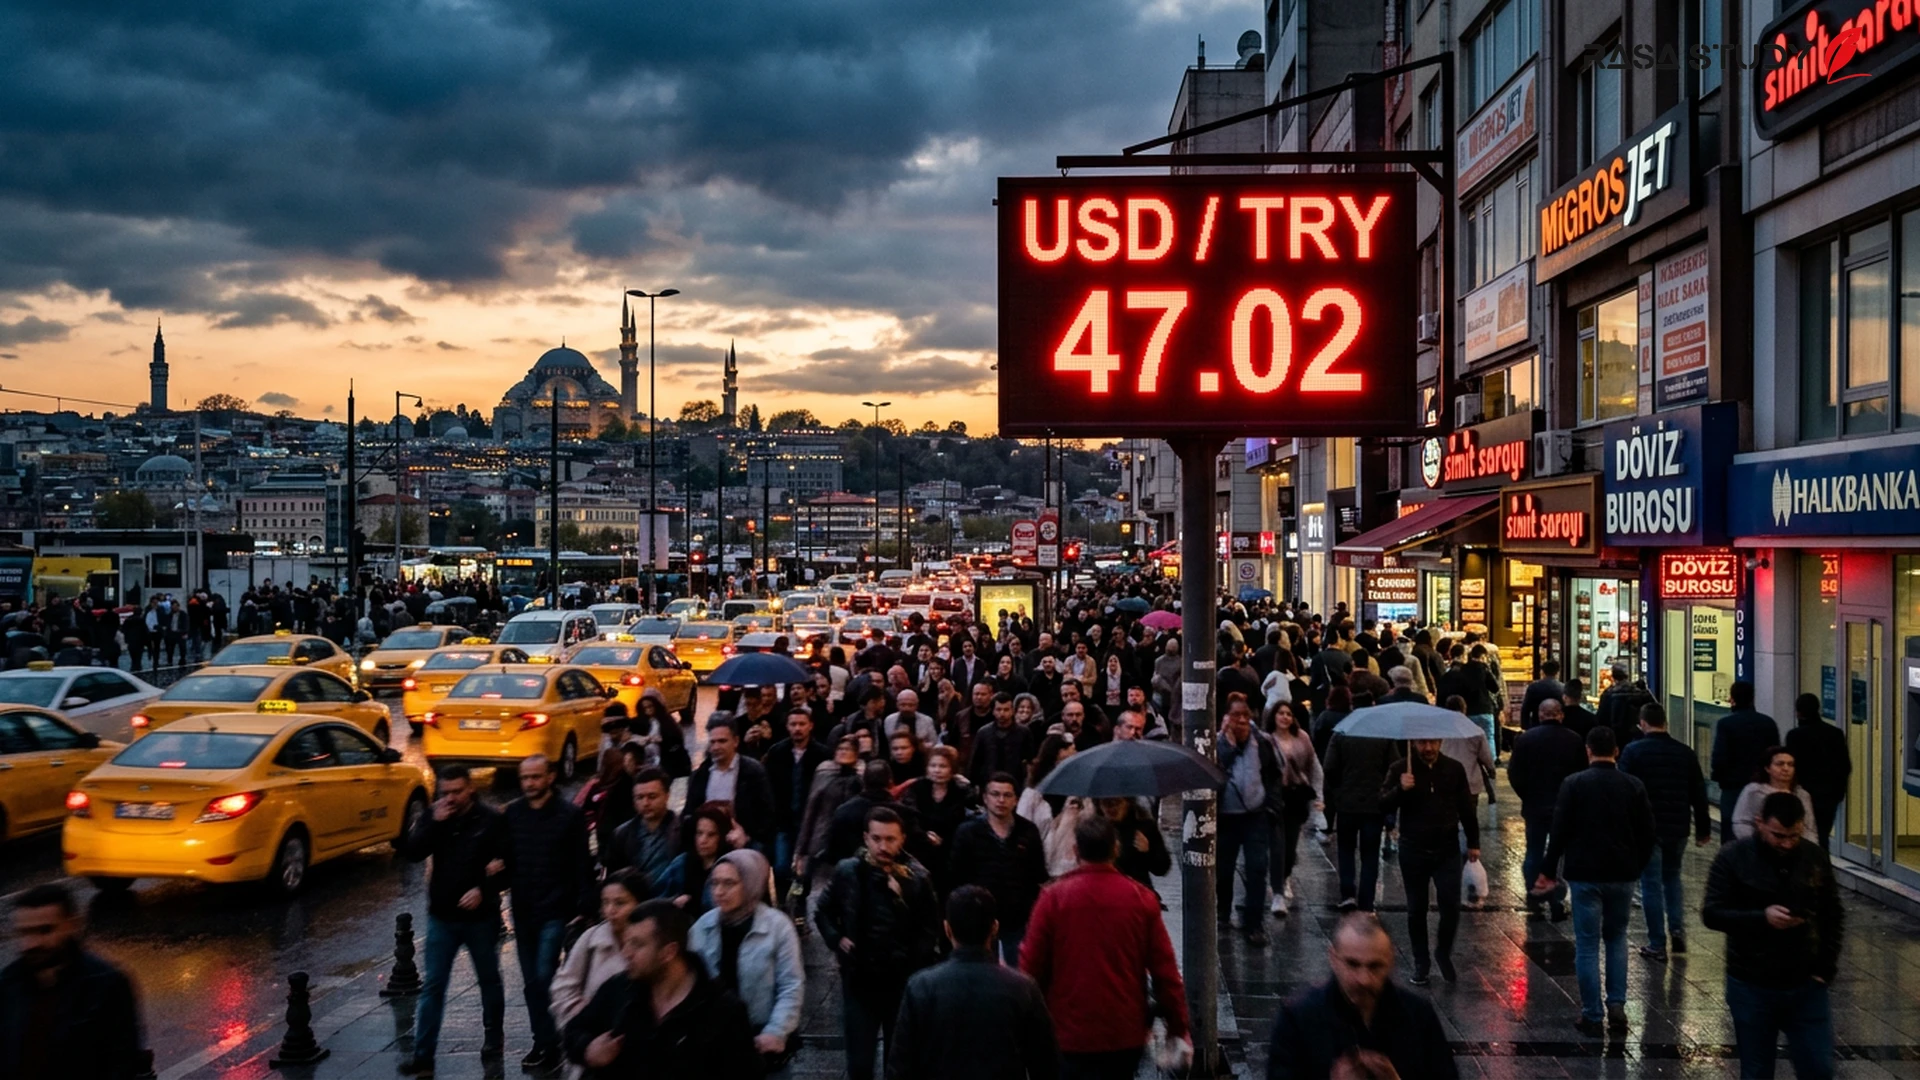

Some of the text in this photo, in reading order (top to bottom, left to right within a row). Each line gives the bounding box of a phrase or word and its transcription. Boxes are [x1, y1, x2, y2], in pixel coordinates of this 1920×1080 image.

[1765, 10, 1829, 112] simit
[1025, 195, 1391, 262] USD / TRY
[1053, 287, 1363, 394] 47.02
[1445, 429, 1475, 481] simit
[1616, 420, 1680, 481] DÖVİZ
[1606, 487, 1692, 534] BUROSU
